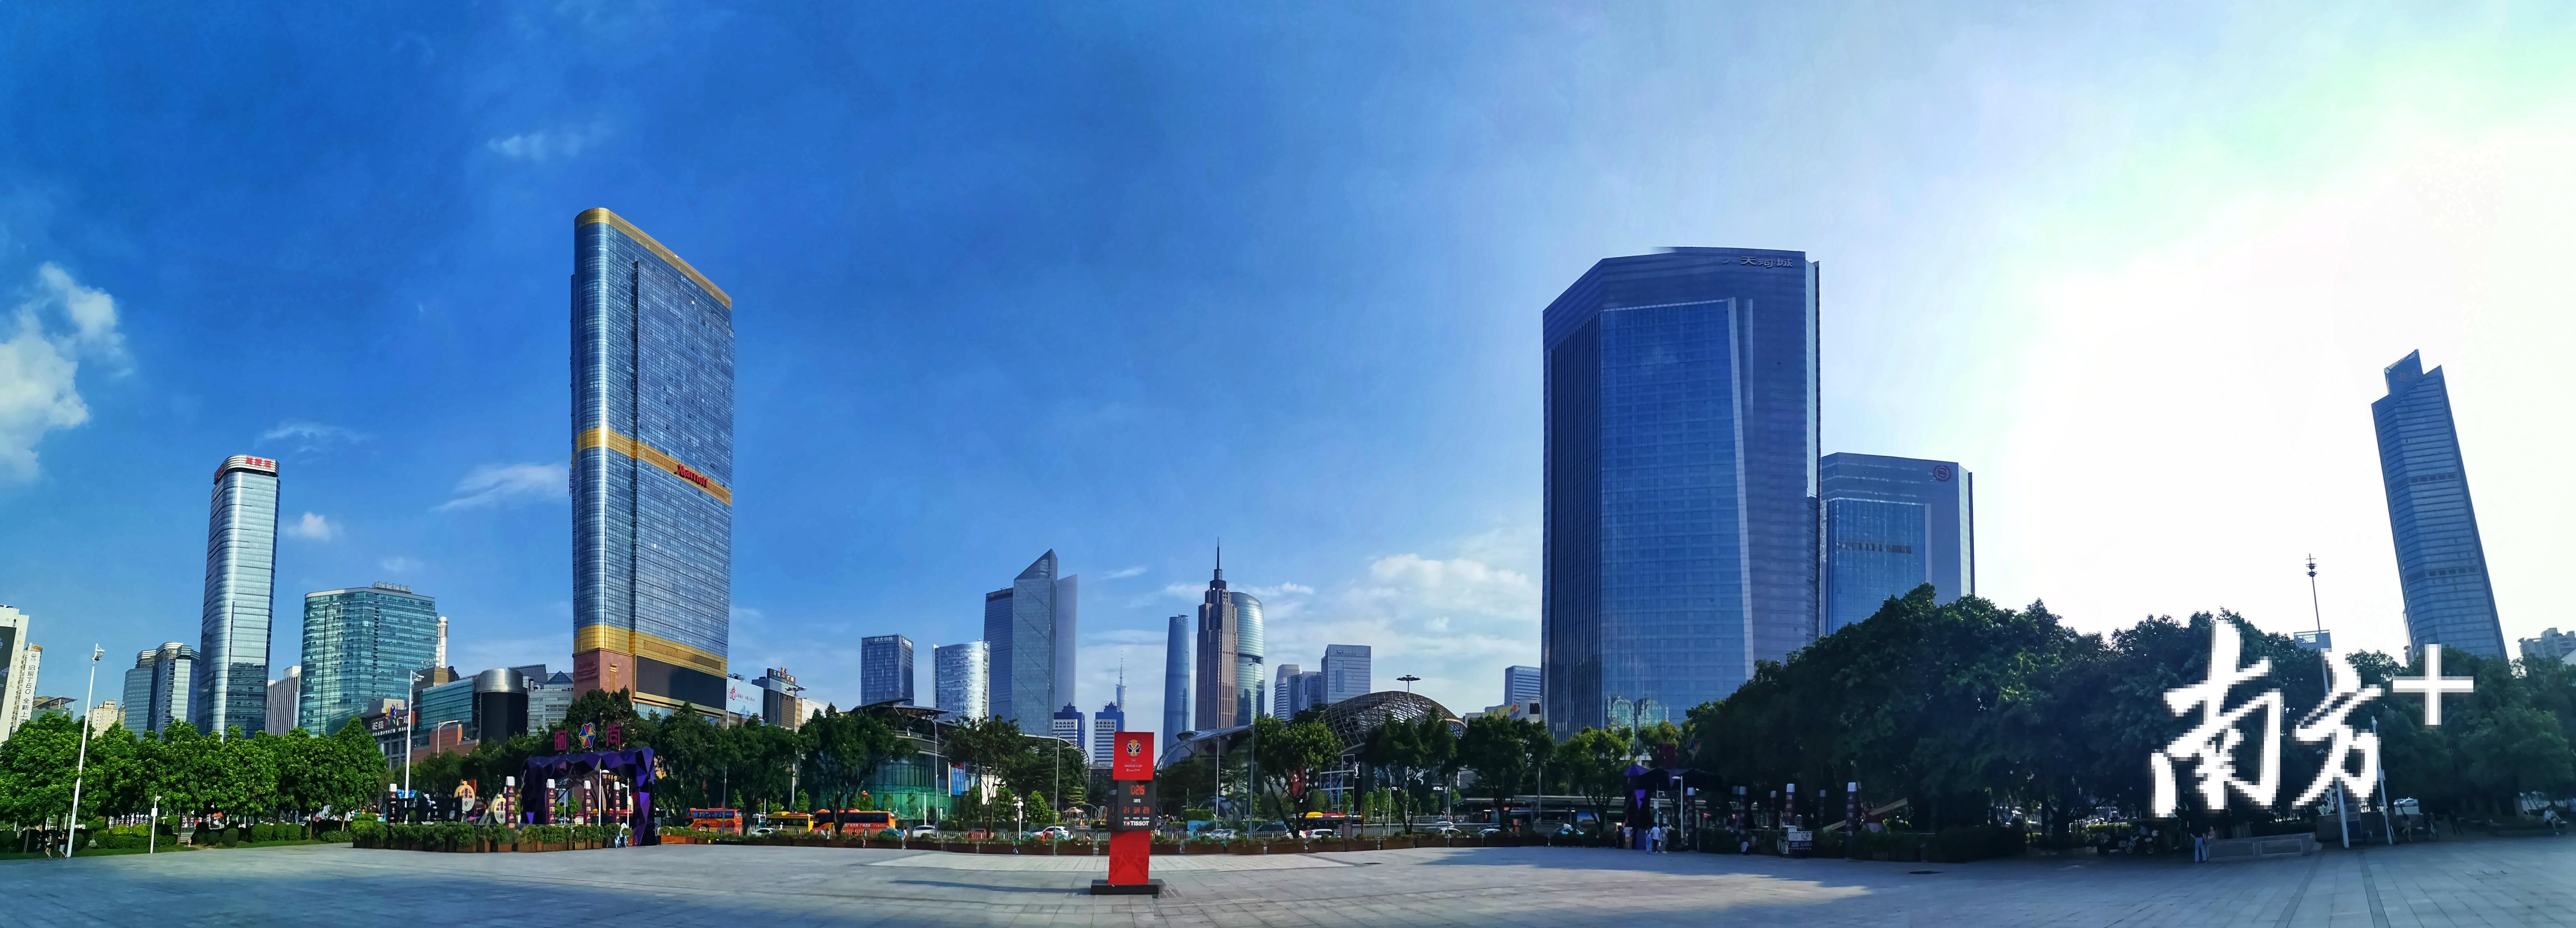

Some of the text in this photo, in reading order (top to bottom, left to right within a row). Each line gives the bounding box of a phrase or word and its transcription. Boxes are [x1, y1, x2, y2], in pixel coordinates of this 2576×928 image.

[1740, 256, 1793, 269] 天河城
[677, 463, 708, 488] Marriott
[24, 665, 36, 694] 启辰T60
[1131, 785, 1145, 795] 026
